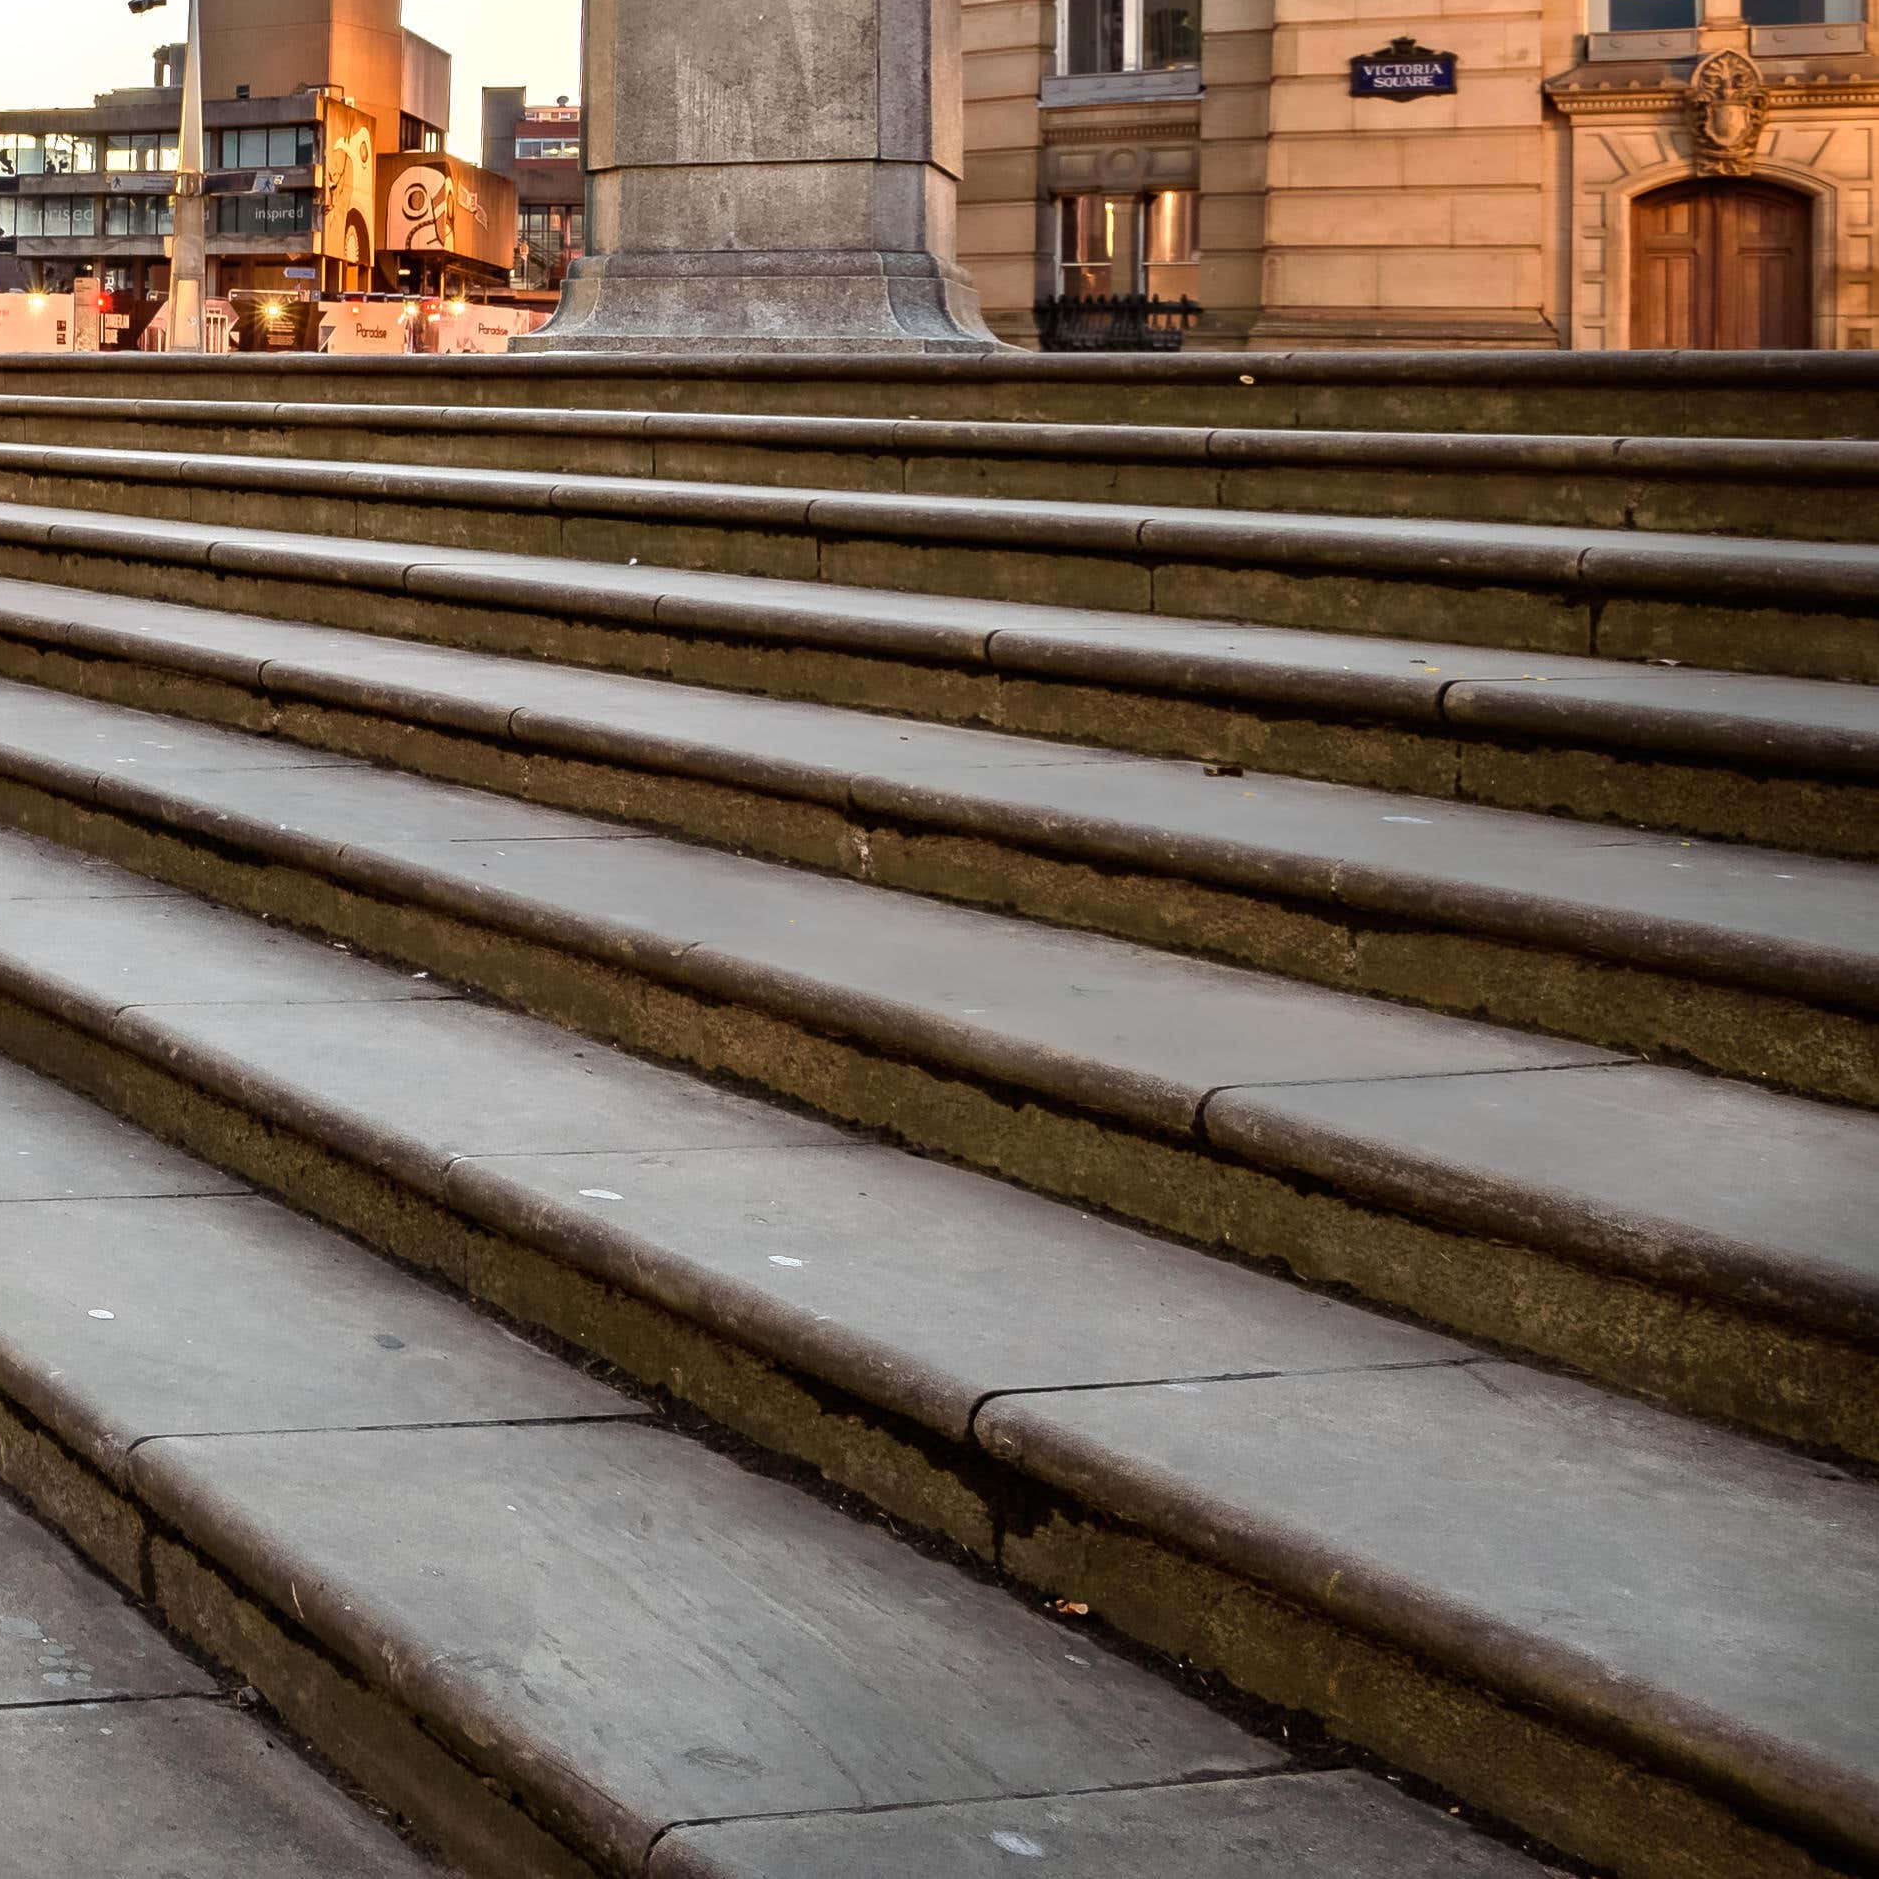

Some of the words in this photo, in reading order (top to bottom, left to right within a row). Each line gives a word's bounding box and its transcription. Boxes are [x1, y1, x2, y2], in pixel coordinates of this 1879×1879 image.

[1363, 63, 1444, 76] VICTORIA
[1373, 75, 1435, 88] SQUARE
[255, 207, 304, 224] inspired
[356, 322, 387, 339] Paradise
[478, 322, 509, 337] Paradise
